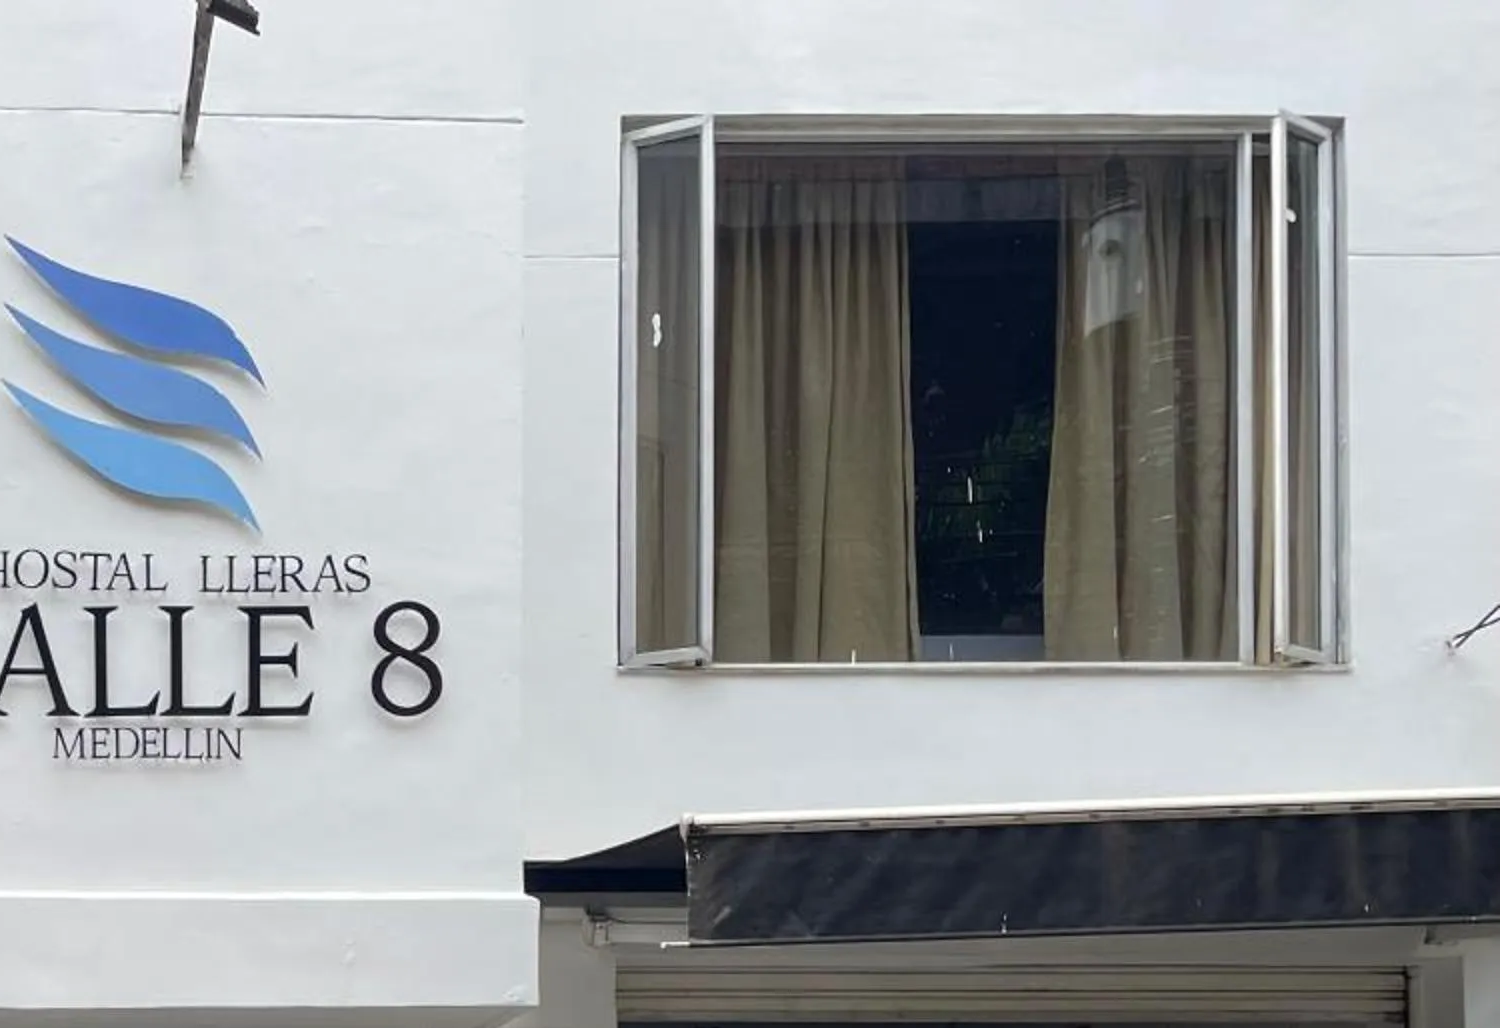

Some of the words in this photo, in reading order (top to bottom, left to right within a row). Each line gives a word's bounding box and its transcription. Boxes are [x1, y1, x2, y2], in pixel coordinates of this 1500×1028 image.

[200, 554, 371, 593] LLERAS
[370, 601, 443, 717] 8
[53, 727, 242, 760] MEDELLIN
